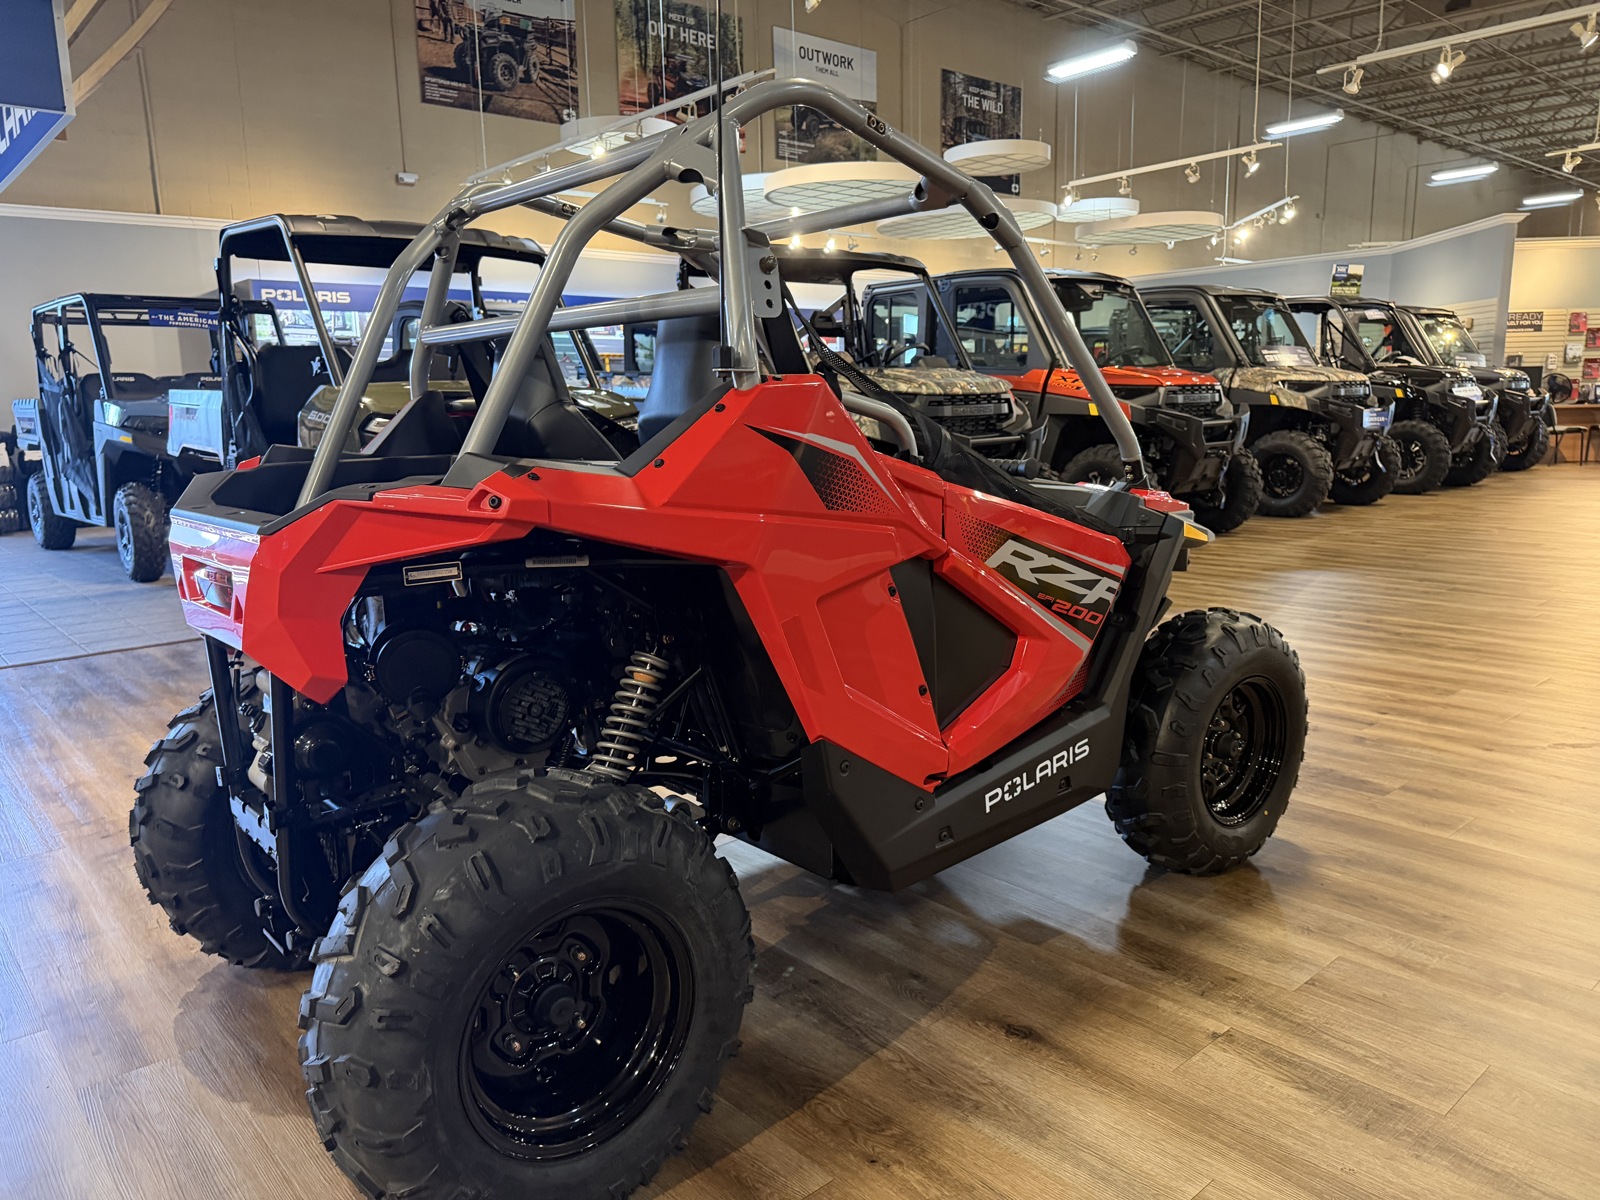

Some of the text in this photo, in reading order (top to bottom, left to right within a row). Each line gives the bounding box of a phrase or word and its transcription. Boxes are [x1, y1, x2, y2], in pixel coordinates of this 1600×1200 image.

[668, 12, 685, 23] MEET
[648, 20, 716, 50] OUT HERE
[798, 45, 855, 71] OUTWORK
[815, 65, 839, 77] THEM ALL
[961, 93, 1004, 115] THE WILD
[260, 288, 351, 304] POLRIS
[177, 315, 219, 326] AMERICAN
[1508, 312, 1543, 321] READY
[1037, 592, 1104, 625] EFI 200
[985, 738, 1090, 814] POLARIS
